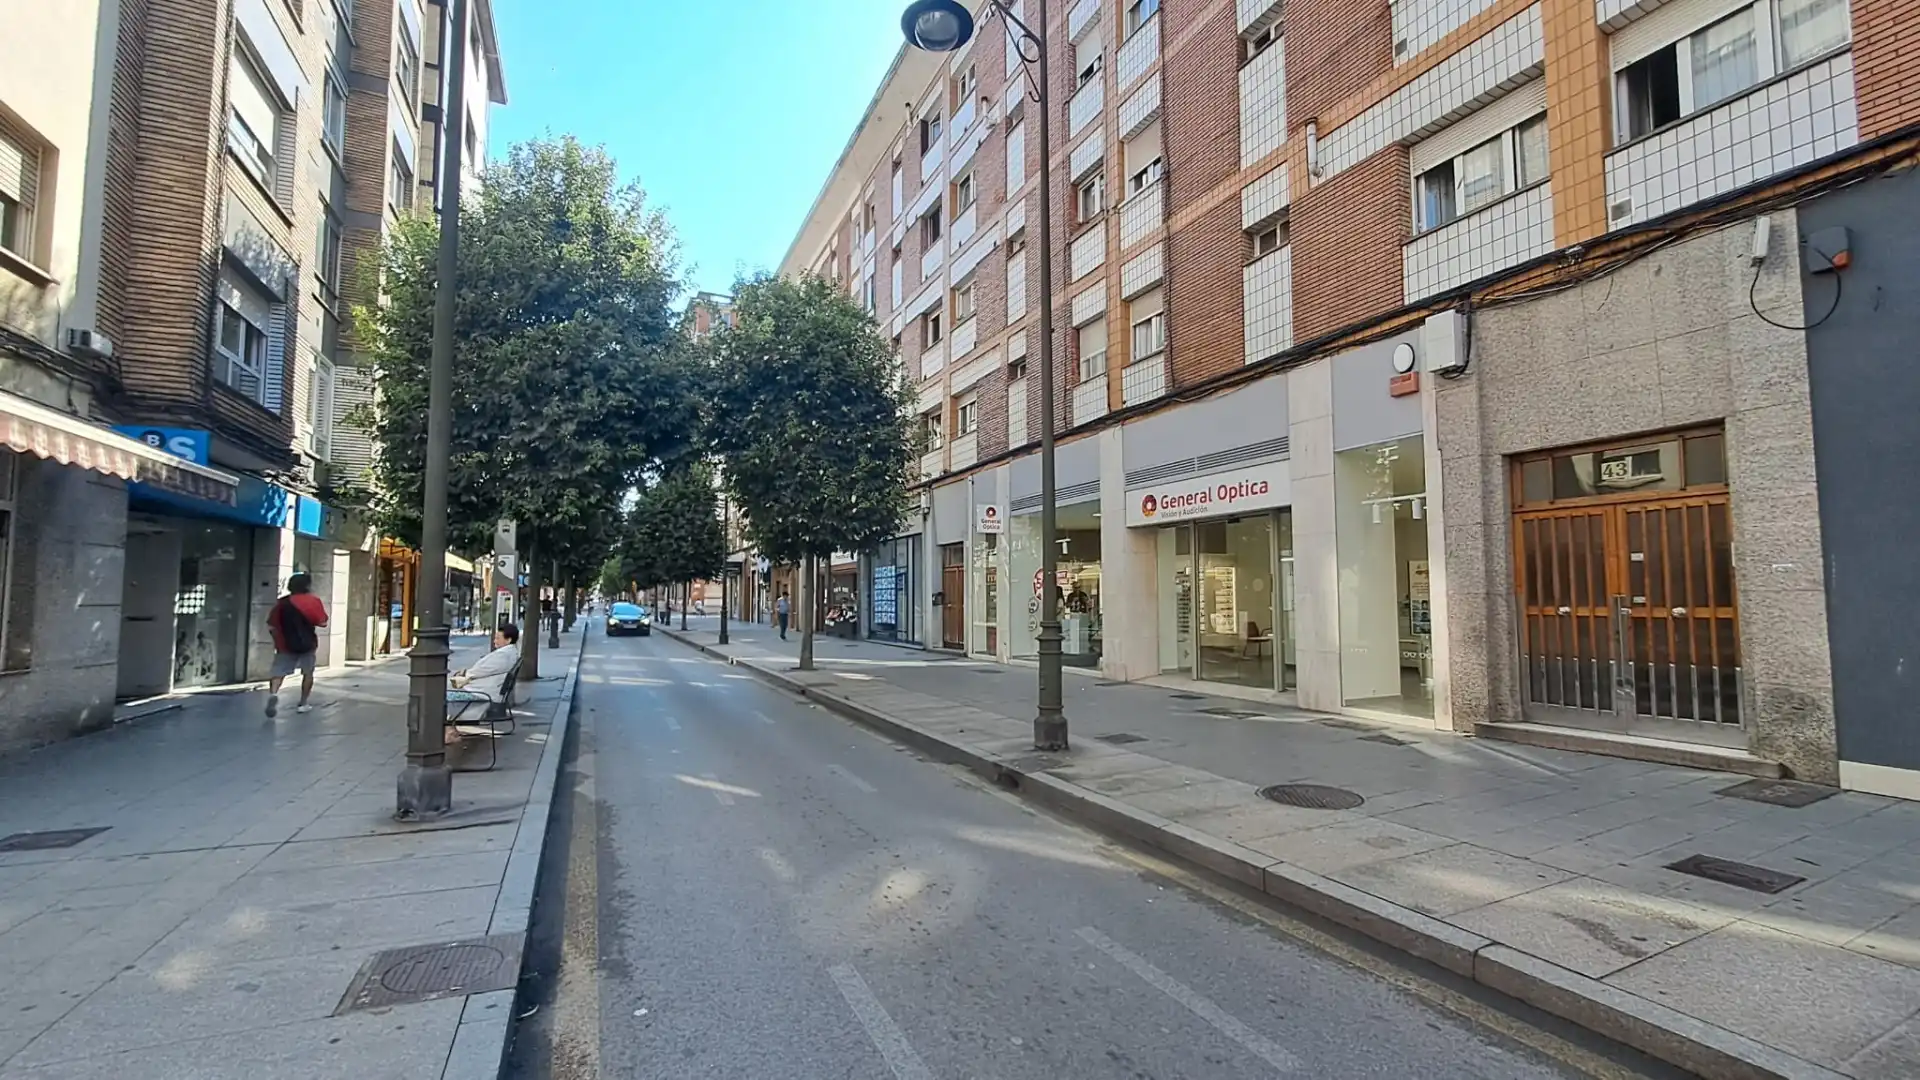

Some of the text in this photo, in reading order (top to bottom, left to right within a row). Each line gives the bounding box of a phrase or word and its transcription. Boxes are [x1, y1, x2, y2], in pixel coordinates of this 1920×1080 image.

[1603, 462, 1627, 477] 43
[1160, 479, 1268, 510] General Optica
